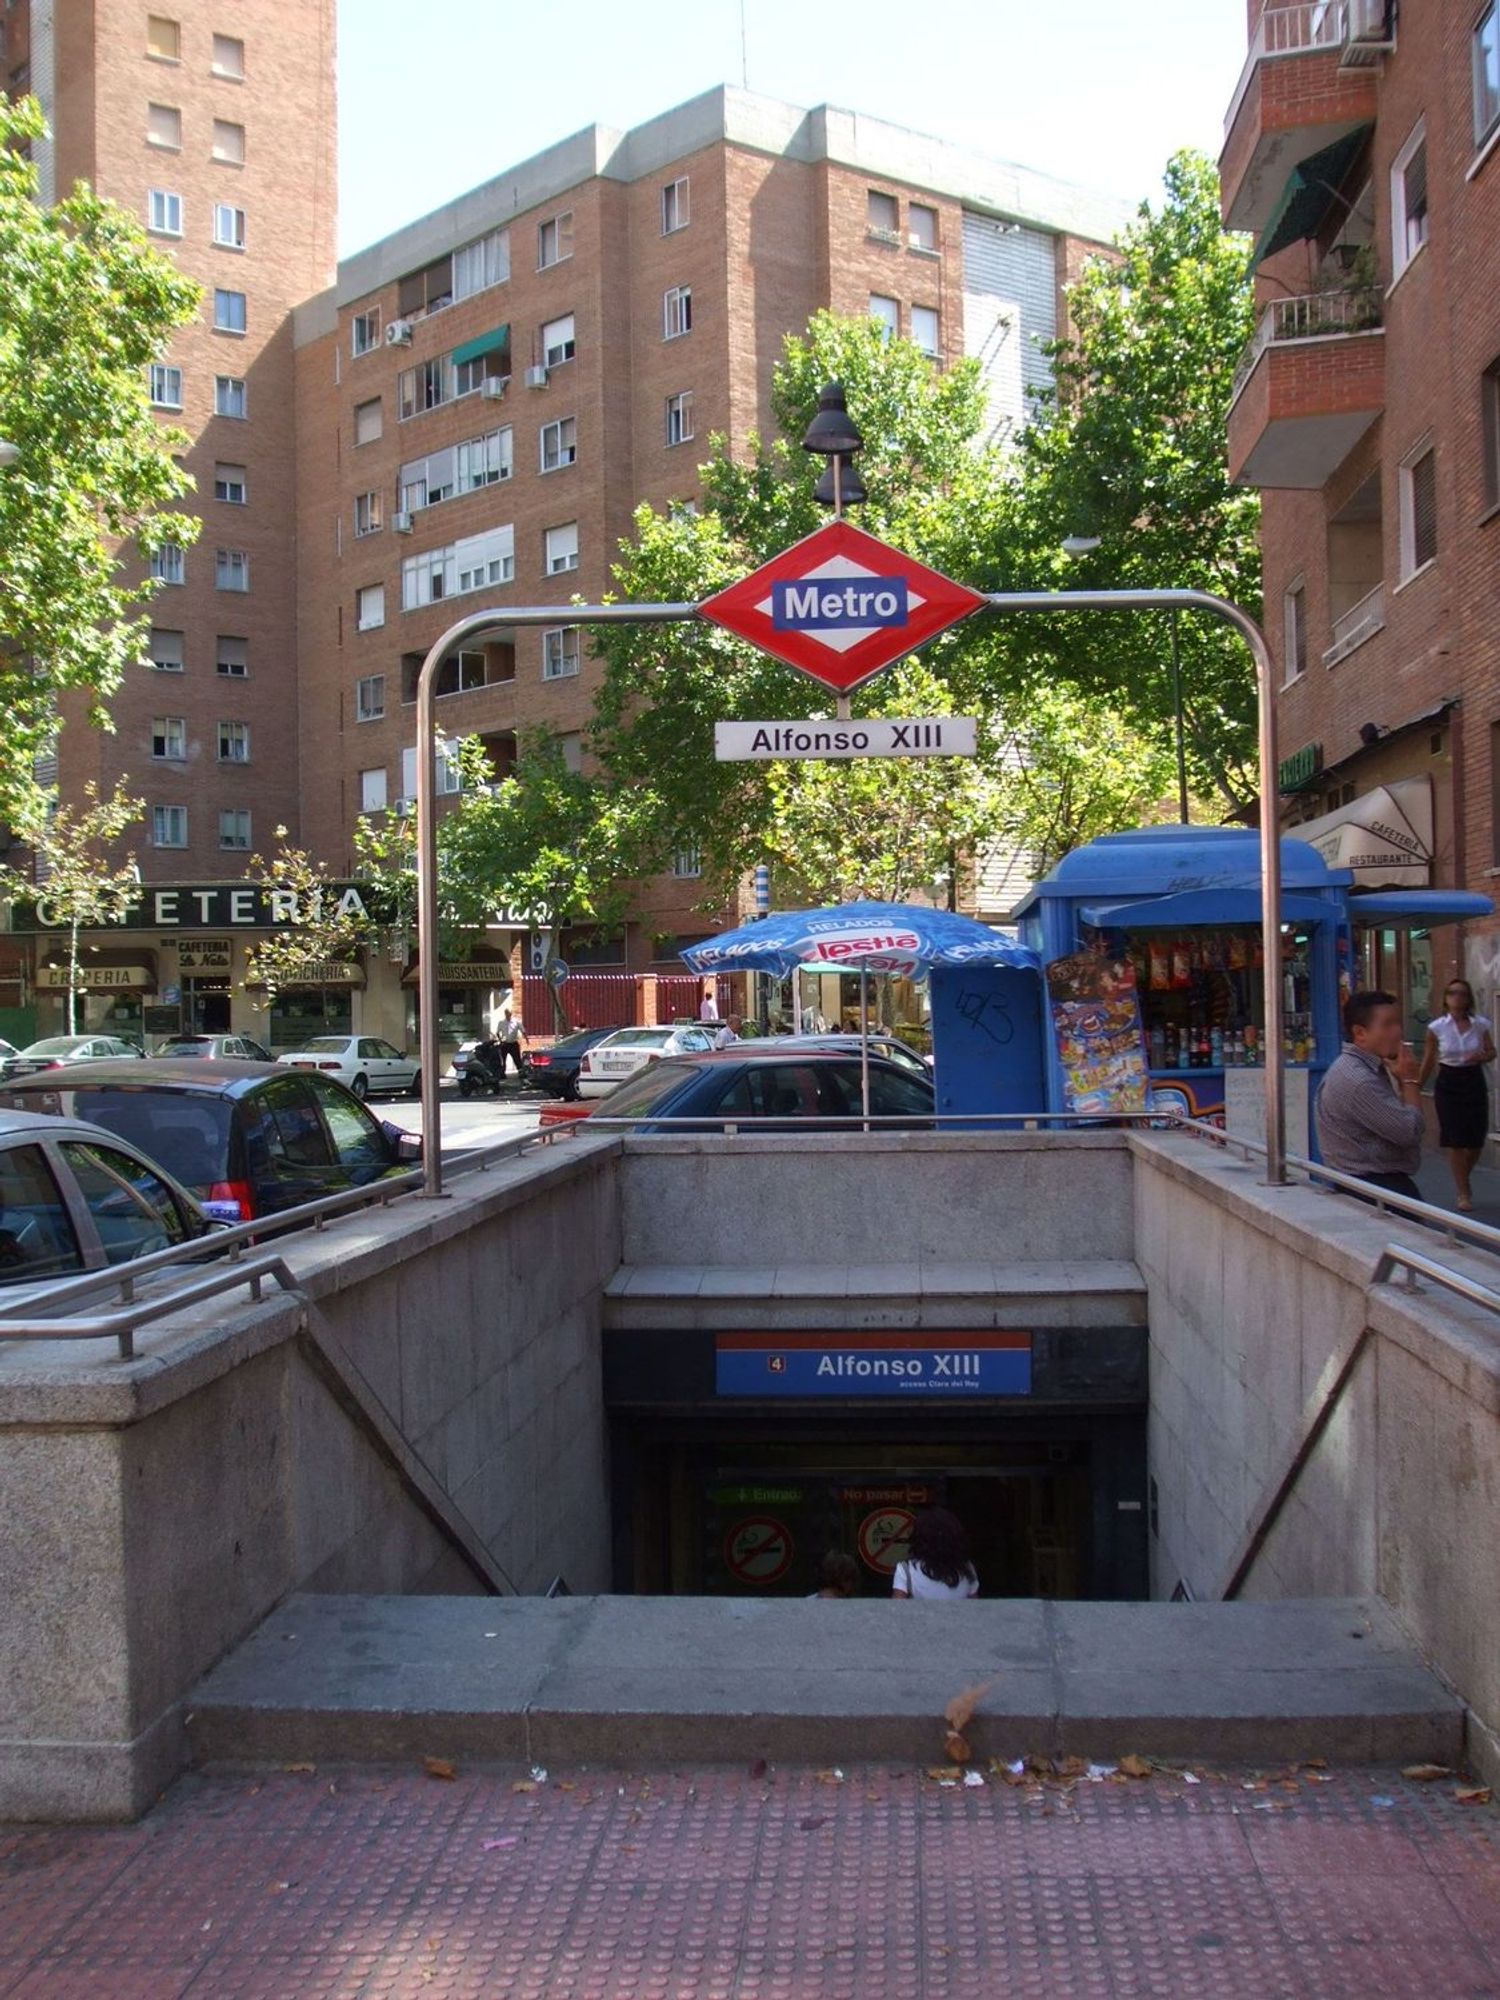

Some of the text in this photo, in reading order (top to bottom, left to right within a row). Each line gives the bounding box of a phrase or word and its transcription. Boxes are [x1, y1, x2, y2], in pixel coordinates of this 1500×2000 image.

[785, 587, 898, 619] Metro
[751, 725, 942, 751] Alfonso XIII
[1371, 821, 1419, 853] CAFETERIA
[1350, 854, 1411, 865] RESTAURANTE
[806, 919, 895, 933] HELADOS
[437, 965, 505, 980] ROISSANTERIA
[771, 1355, 980, 1376] 4 Alfonso XIII
[753, 1488, 802, 1501] Entrad
